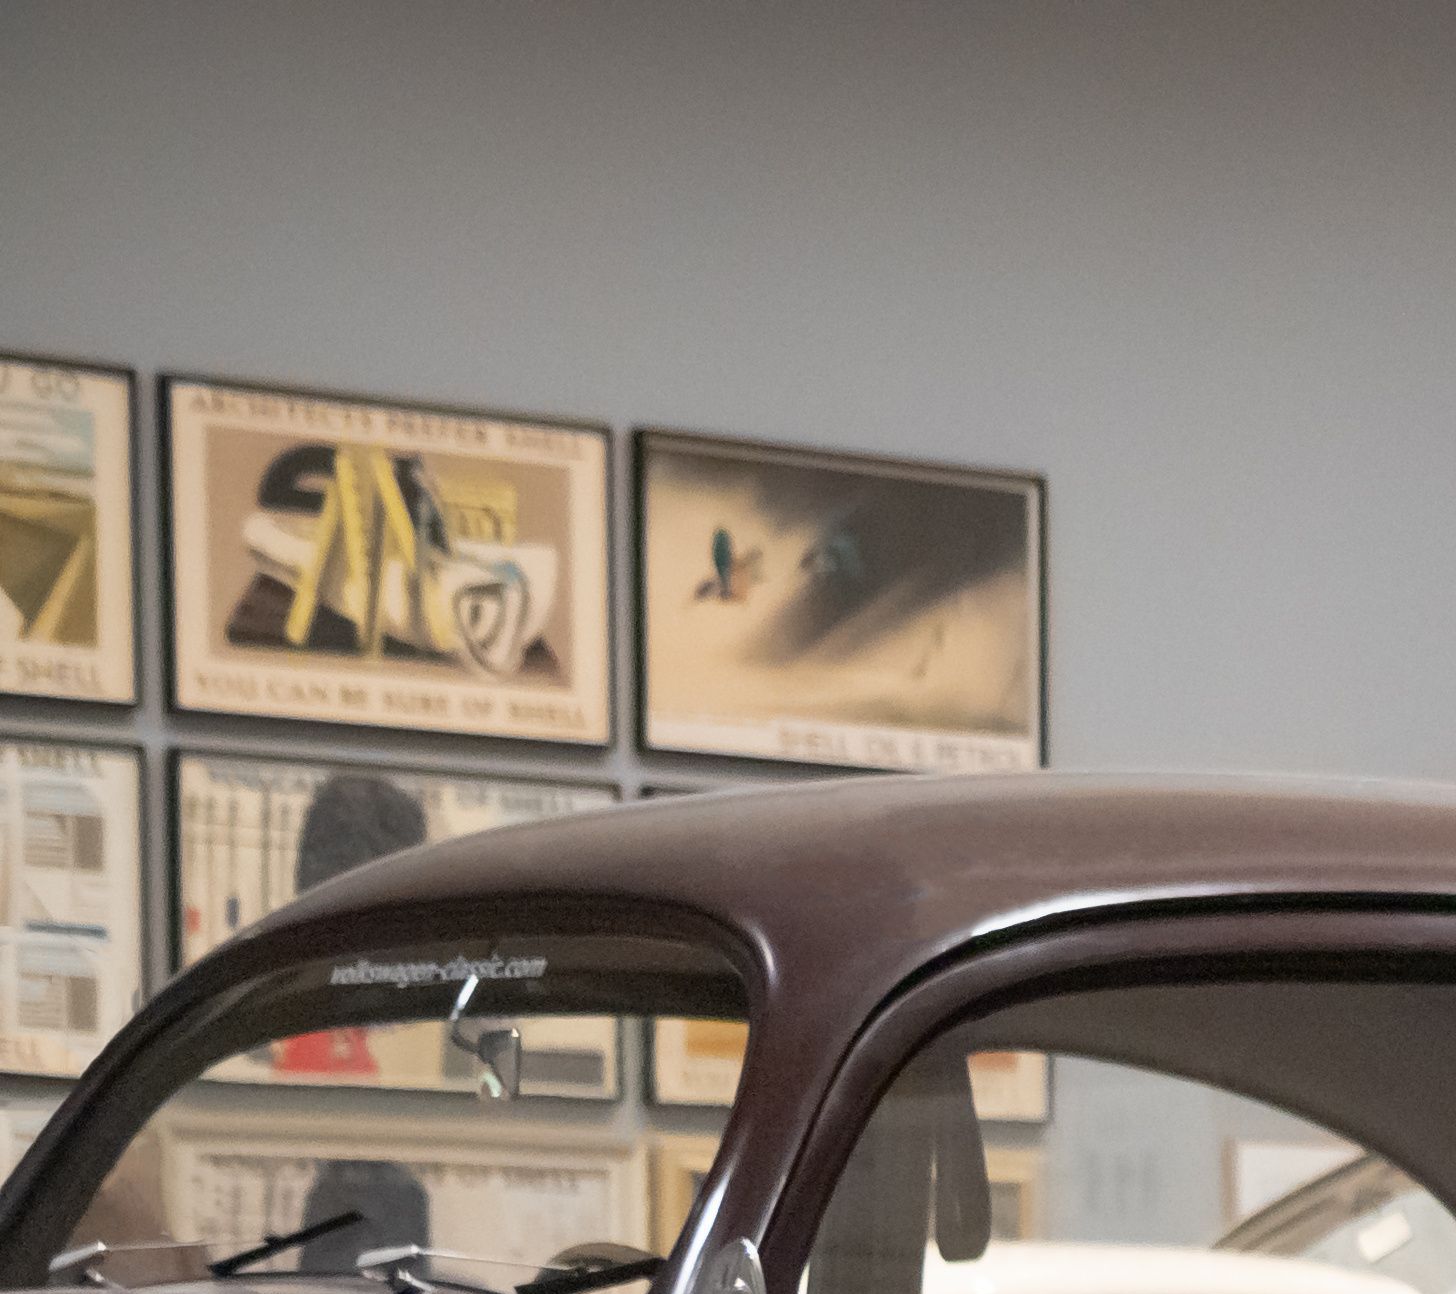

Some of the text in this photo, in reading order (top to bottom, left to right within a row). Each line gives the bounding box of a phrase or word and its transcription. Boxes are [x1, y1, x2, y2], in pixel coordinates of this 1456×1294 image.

[17, 657, 103, 692] SHELL
[264, 677, 329, 704] CAN
[382, 691, 448, 717] SURE
[460, 698, 497, 720] OF
[506, 702, 588, 732] SHELL
